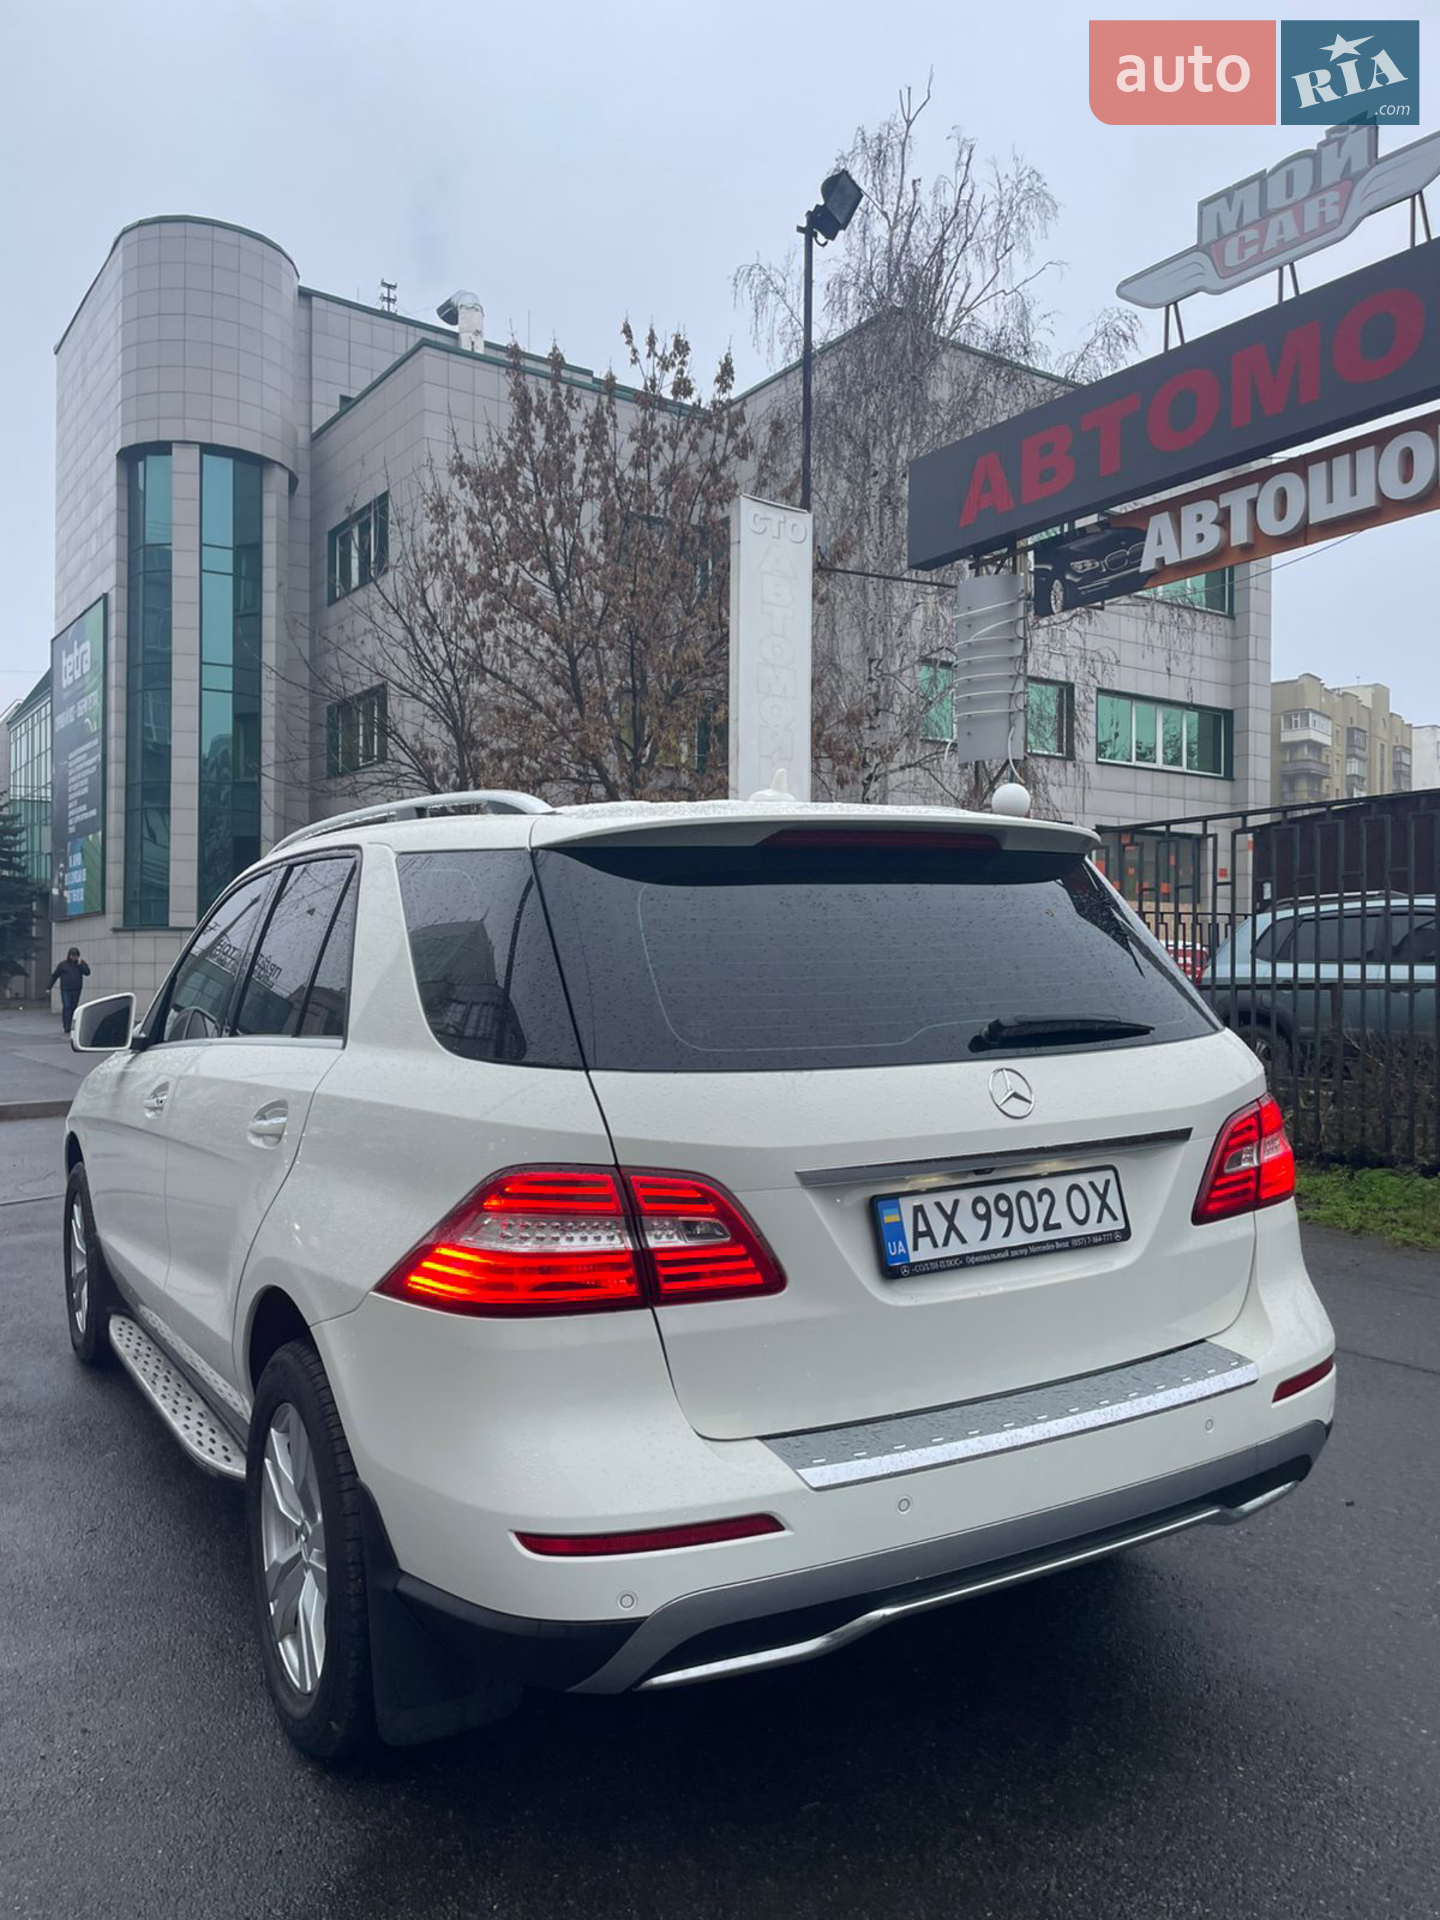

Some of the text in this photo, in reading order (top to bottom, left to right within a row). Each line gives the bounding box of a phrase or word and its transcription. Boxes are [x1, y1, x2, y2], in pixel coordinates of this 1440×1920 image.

[1200, 120, 1371, 246] МОЙ
[1223, 191, 1342, 269] CAR
[750, 511, 808, 544] СТО
[1139, 423, 1440, 574] АВТОШО
[61, 639, 91, 690] tetra
[888, 1240, 907, 1256] UA
[911, 1178, 1119, 1252] AX 9902 OX
